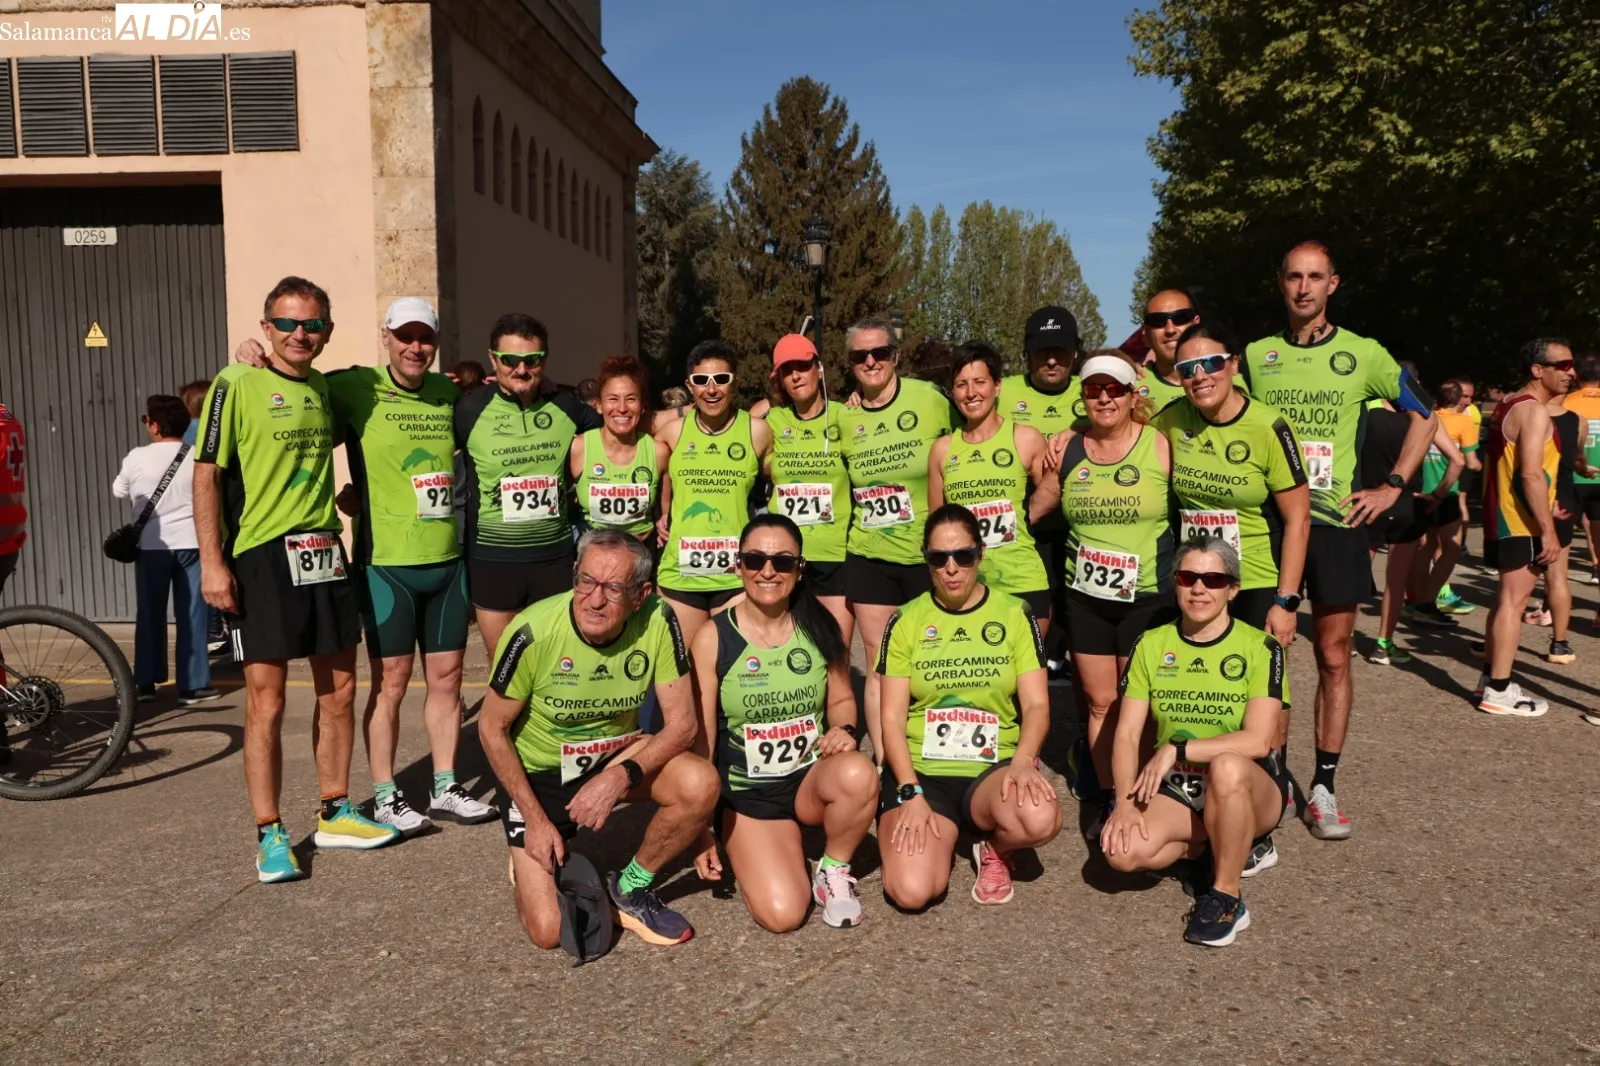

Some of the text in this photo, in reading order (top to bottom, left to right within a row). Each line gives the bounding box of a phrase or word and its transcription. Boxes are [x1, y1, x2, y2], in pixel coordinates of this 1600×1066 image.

[74, 230, 107, 244] 0259
[1265, 389, 1346, 406] CORRECAMINOS
[206, 387, 223, 453] CORRECAMINOS
[1280, 408, 1339, 425] RBAJOSA
[1296, 426, 1336, 438] MANCA
[491, 440, 562, 457] CORRECAMINOS
[848, 439, 923, 461] CORRECAMINOS
[1283, 431, 1300, 471] CARBAJOSA
[501, 453, 557, 467] CARBAJOSA
[778, 460, 836, 468] CARBAJOSA
[854, 450, 916, 470] CARBAJOSA
[678, 468, 747, 478] CORRECAMINOS
[861, 462, 908, 477] SALAMANCA
[1173, 463, 1249, 486] ORRECAMINOS
[684, 478, 738, 487] CARBAJOSA
[427, 487, 454, 507] 92
[512, 489, 552, 511] 934
[590, 486, 648, 497] bedunia
[950, 489, 1006, 501] CARBAJOSA
[599, 497, 640, 515] 803
[785, 496, 821, 516] 921
[1068, 495, 1141, 508] CORRECAMINOS
[972, 504, 1014, 518] dunia
[1069, 508, 1140, 519] CARBAJOSA
[979, 515, 1007, 538] 94
[299, 549, 333, 572] 877
[689, 551, 731, 569] 898
[1083, 562, 1125, 589] 932
[915, 655, 1010, 671] CORRECAMINOS
[924, 668, 1001, 681] CARBAJOSA
[935, 680, 990, 690] SALAMANCA
[543, 690, 648, 710] CORRECAMINO
[742, 683, 818, 708] CORRECAMINOS
[1151, 688, 1247, 703] CORRECAMINOS
[745, 700, 817, 720] CARBAJOSA
[927, 709, 998, 724] bedunia
[1158, 702, 1235, 716] CARBAJOSA
[1168, 715, 1224, 726] SALAMANCA
[758, 735, 808, 764] 929
